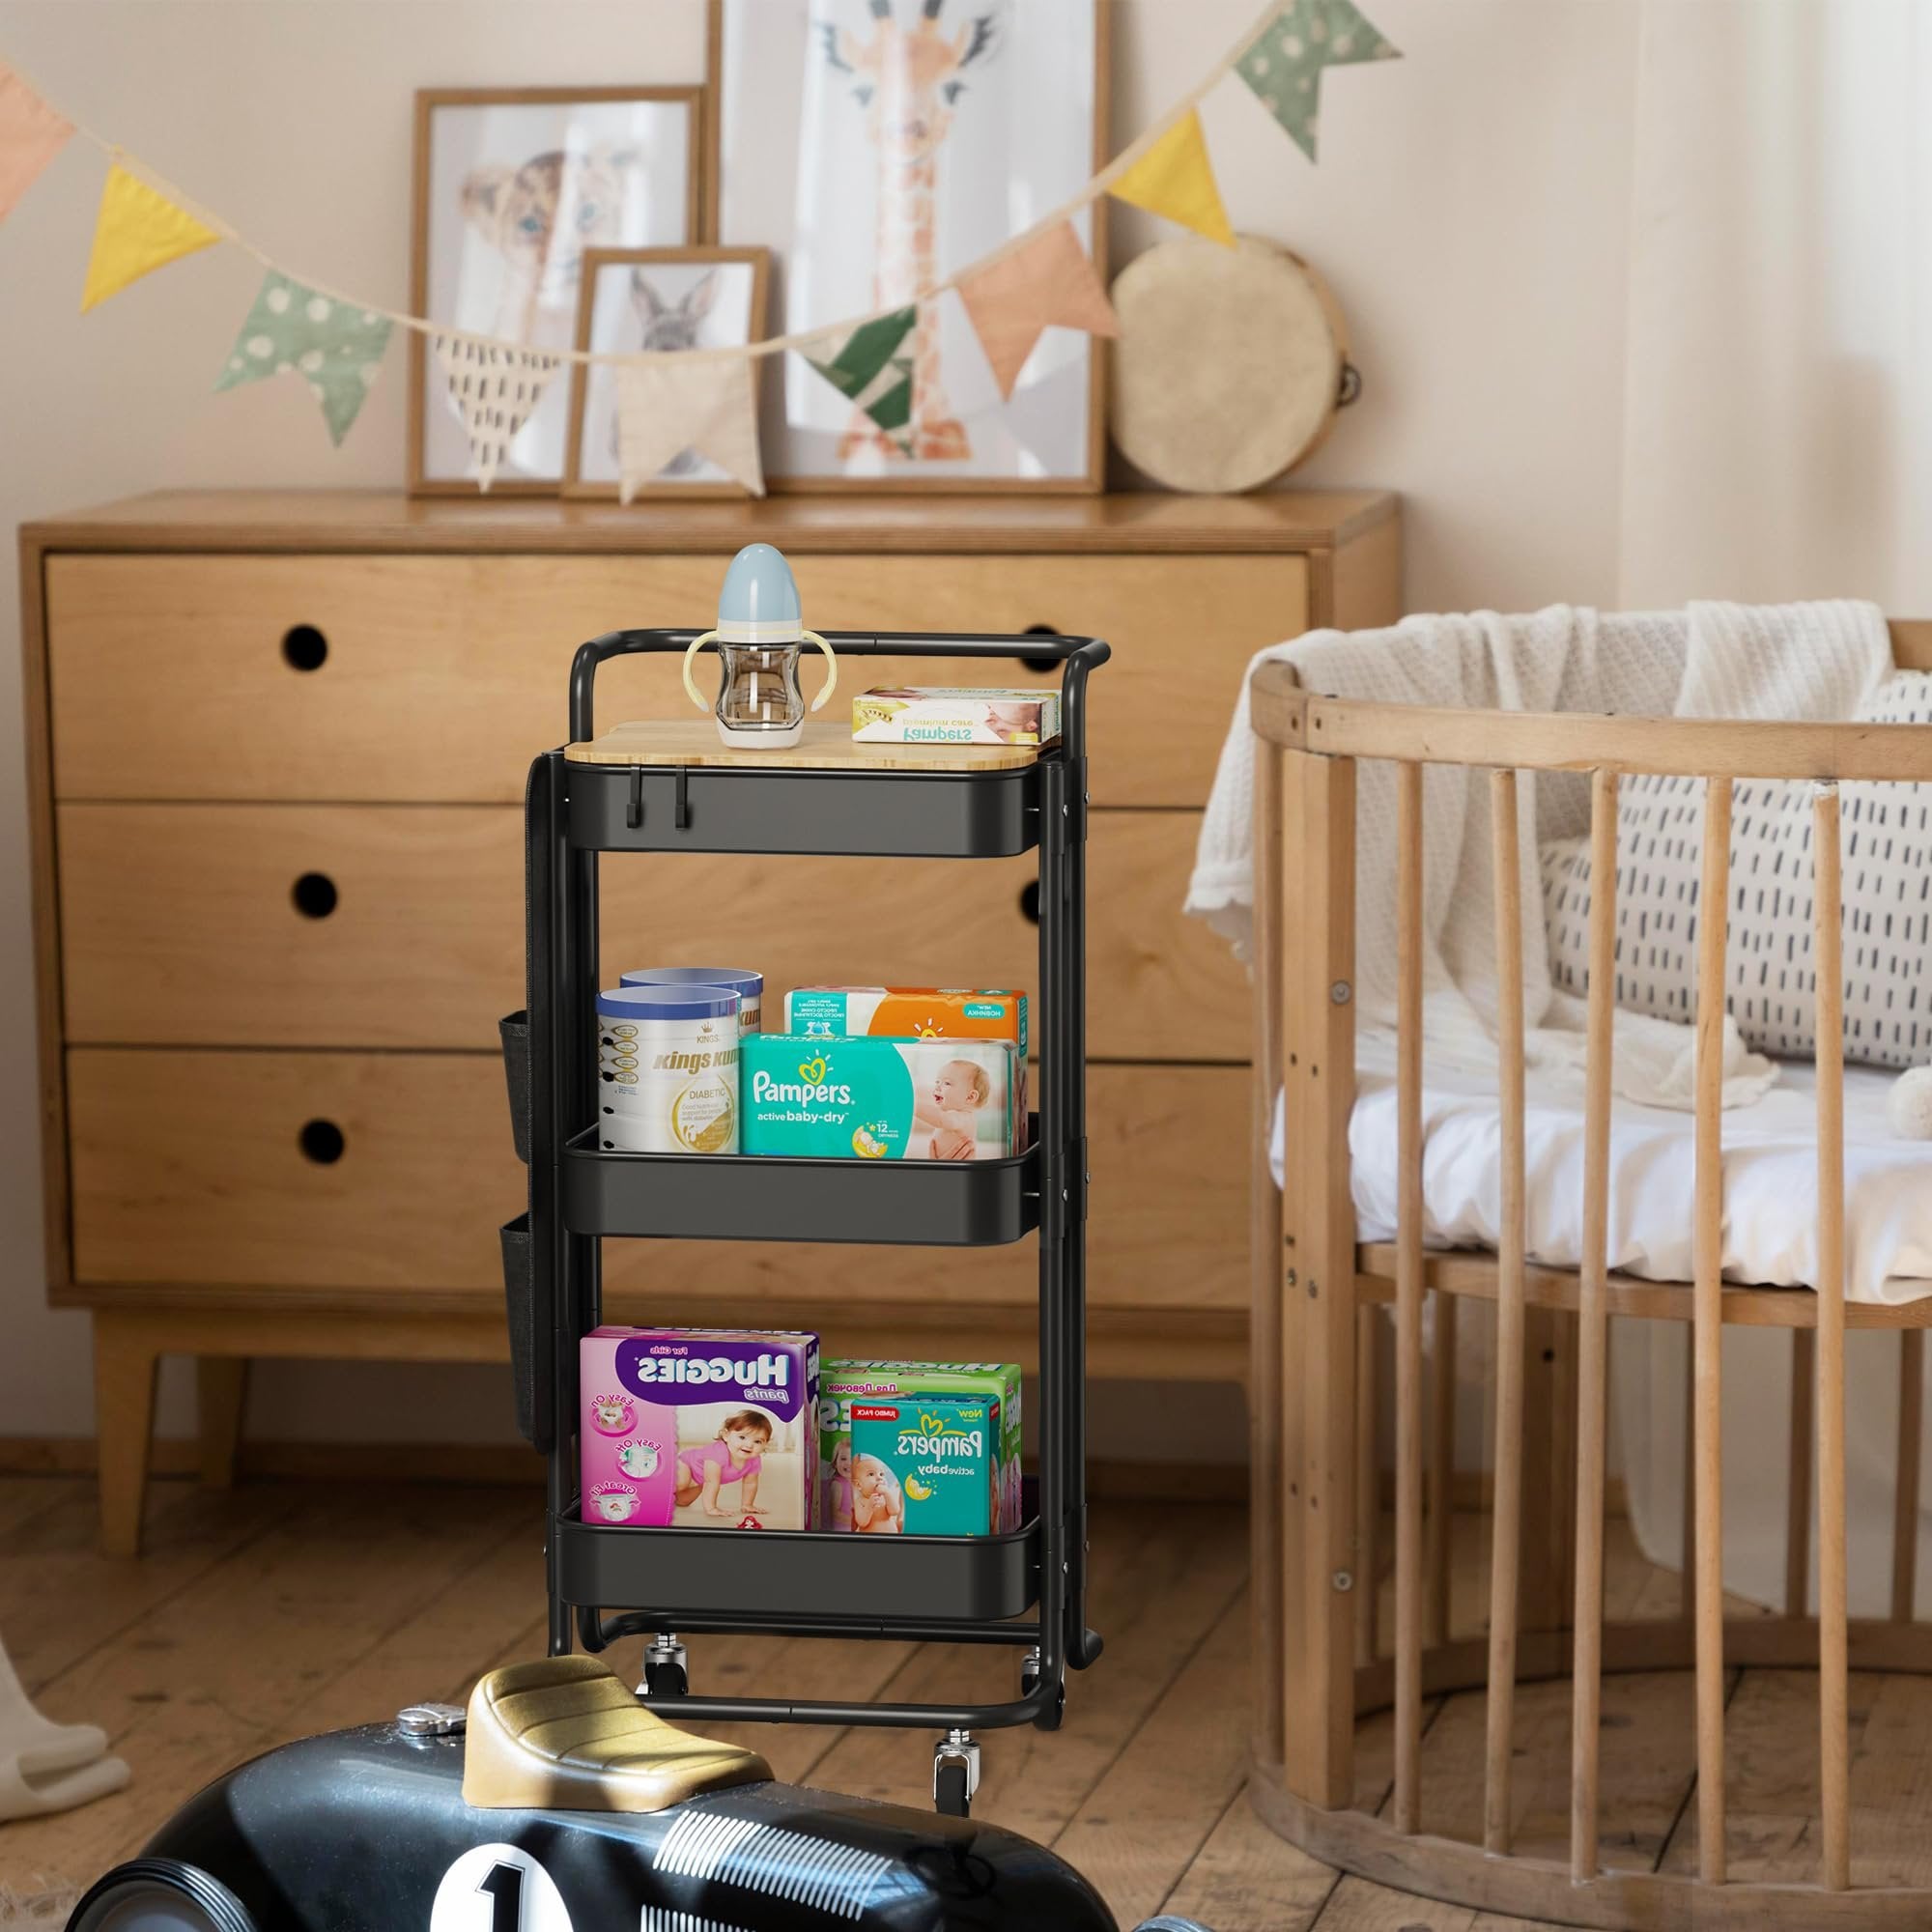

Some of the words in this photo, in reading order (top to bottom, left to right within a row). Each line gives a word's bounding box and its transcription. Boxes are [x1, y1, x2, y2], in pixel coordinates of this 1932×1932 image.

[696, 1035, 719, 1044] KINGS
[689, 1088, 726, 1100] DIABETIC
[753, 1070, 852, 1108] Pampers
[757, 1111, 785, 1121] active
[786, 1111, 846, 1124] baby-dry
[875, 1123, 888, 1133] 12
[474, 1860, 526, 1932] 1
